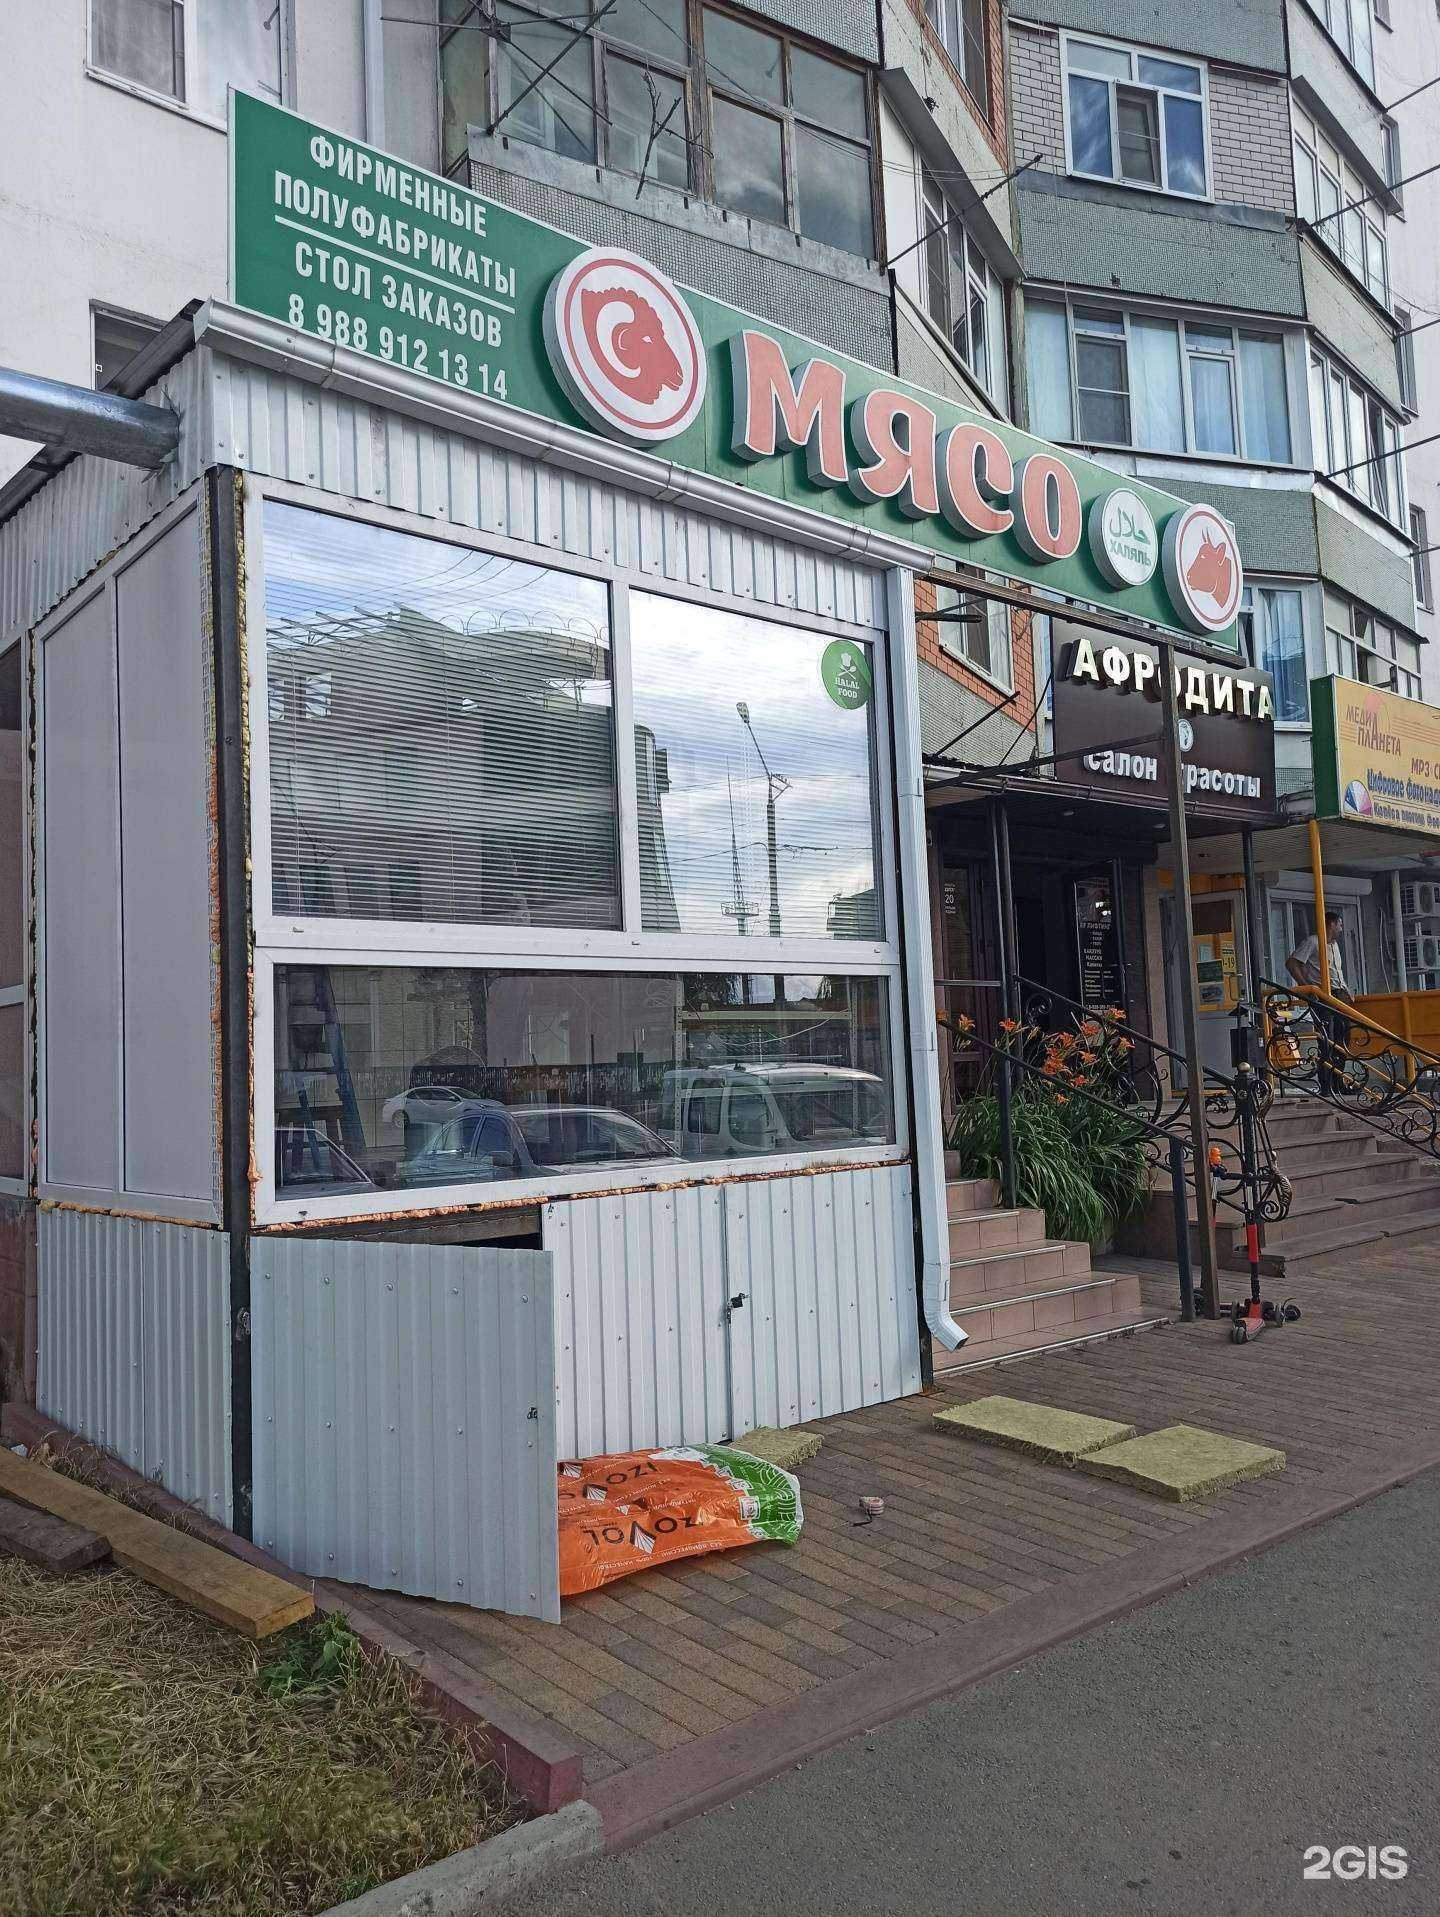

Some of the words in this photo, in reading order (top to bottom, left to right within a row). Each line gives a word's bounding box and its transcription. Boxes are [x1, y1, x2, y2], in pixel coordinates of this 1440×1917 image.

[310, 135, 487, 237] ФИРМЕННЫЕ
[275, 170, 516, 298] ПОЛУФАБРИКАТЫ
[295, 241, 371, 300] СТОЛ
[382, 274, 502, 348] ЗАКАЗОВ
[288, 293, 304, 329] 8
[316, 304, 368, 351] 988
[379, 326, 428, 373] 912
[438, 349, 468, 386] 13
[478, 363, 507, 400] 14
[738, 329, 1082, 560] МЯСО
[1109, 505, 1151, 545] حلال
[1109, 538, 1152, 567] ХАЛЯЛЬ
[835, 676, 860, 690] HALAL
[837, 687, 858, 699] FOOD
[1181, 763, 1261, 798] расоты
